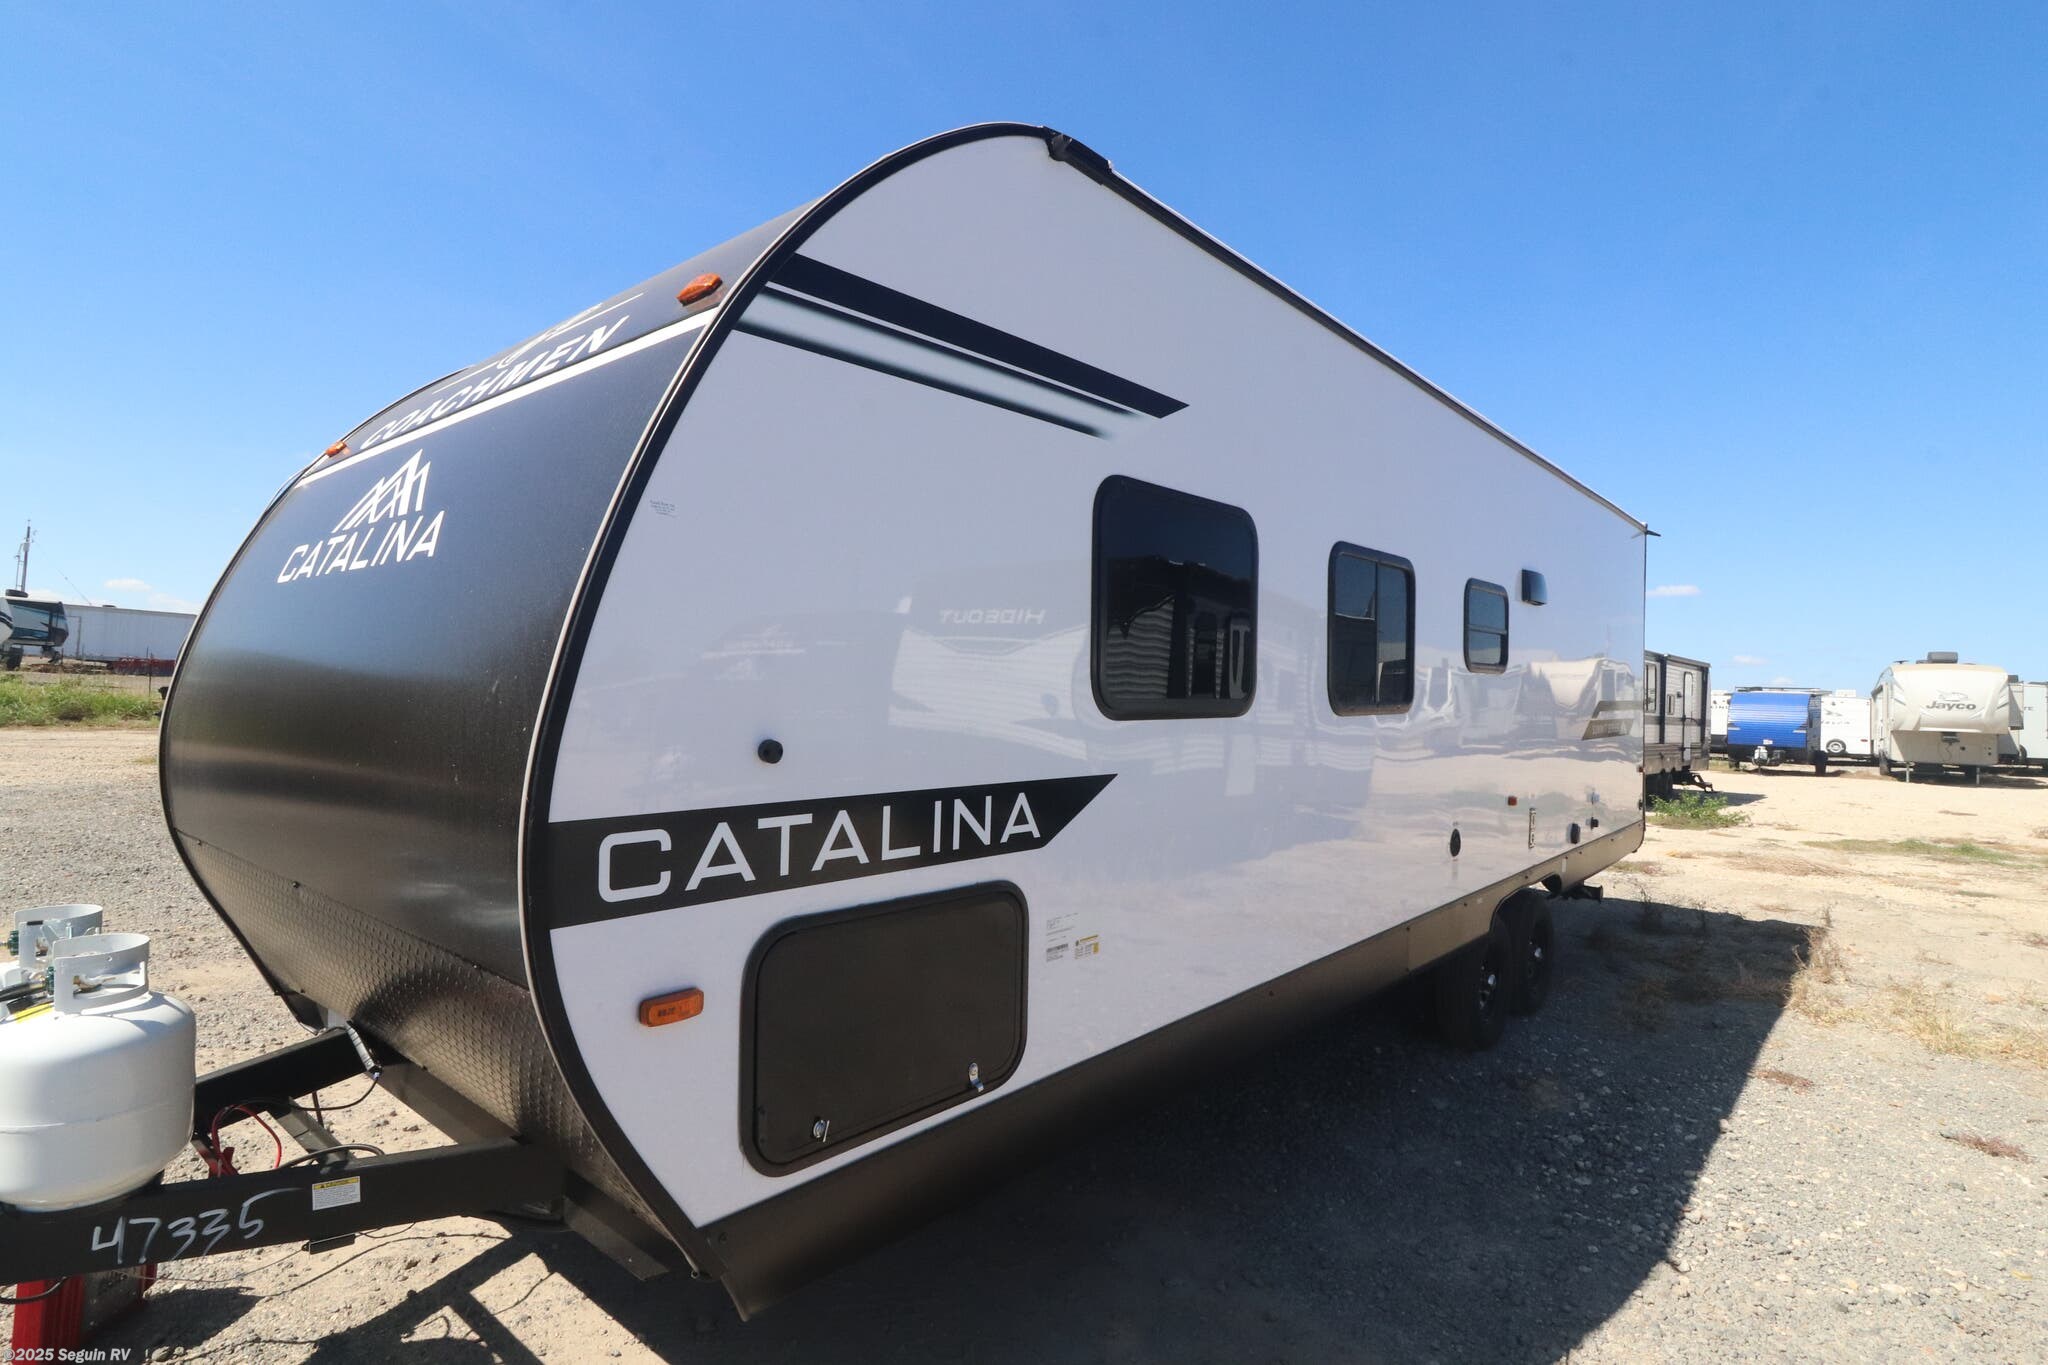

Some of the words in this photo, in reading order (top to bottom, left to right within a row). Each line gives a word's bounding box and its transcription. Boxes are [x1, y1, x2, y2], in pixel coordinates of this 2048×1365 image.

[360, 315, 630, 450] COACHMEN
[277, 510, 446, 585] CATALINA
[1926, 701, 1977, 711] Jayco
[598, 791, 1041, 903] CATALINA
